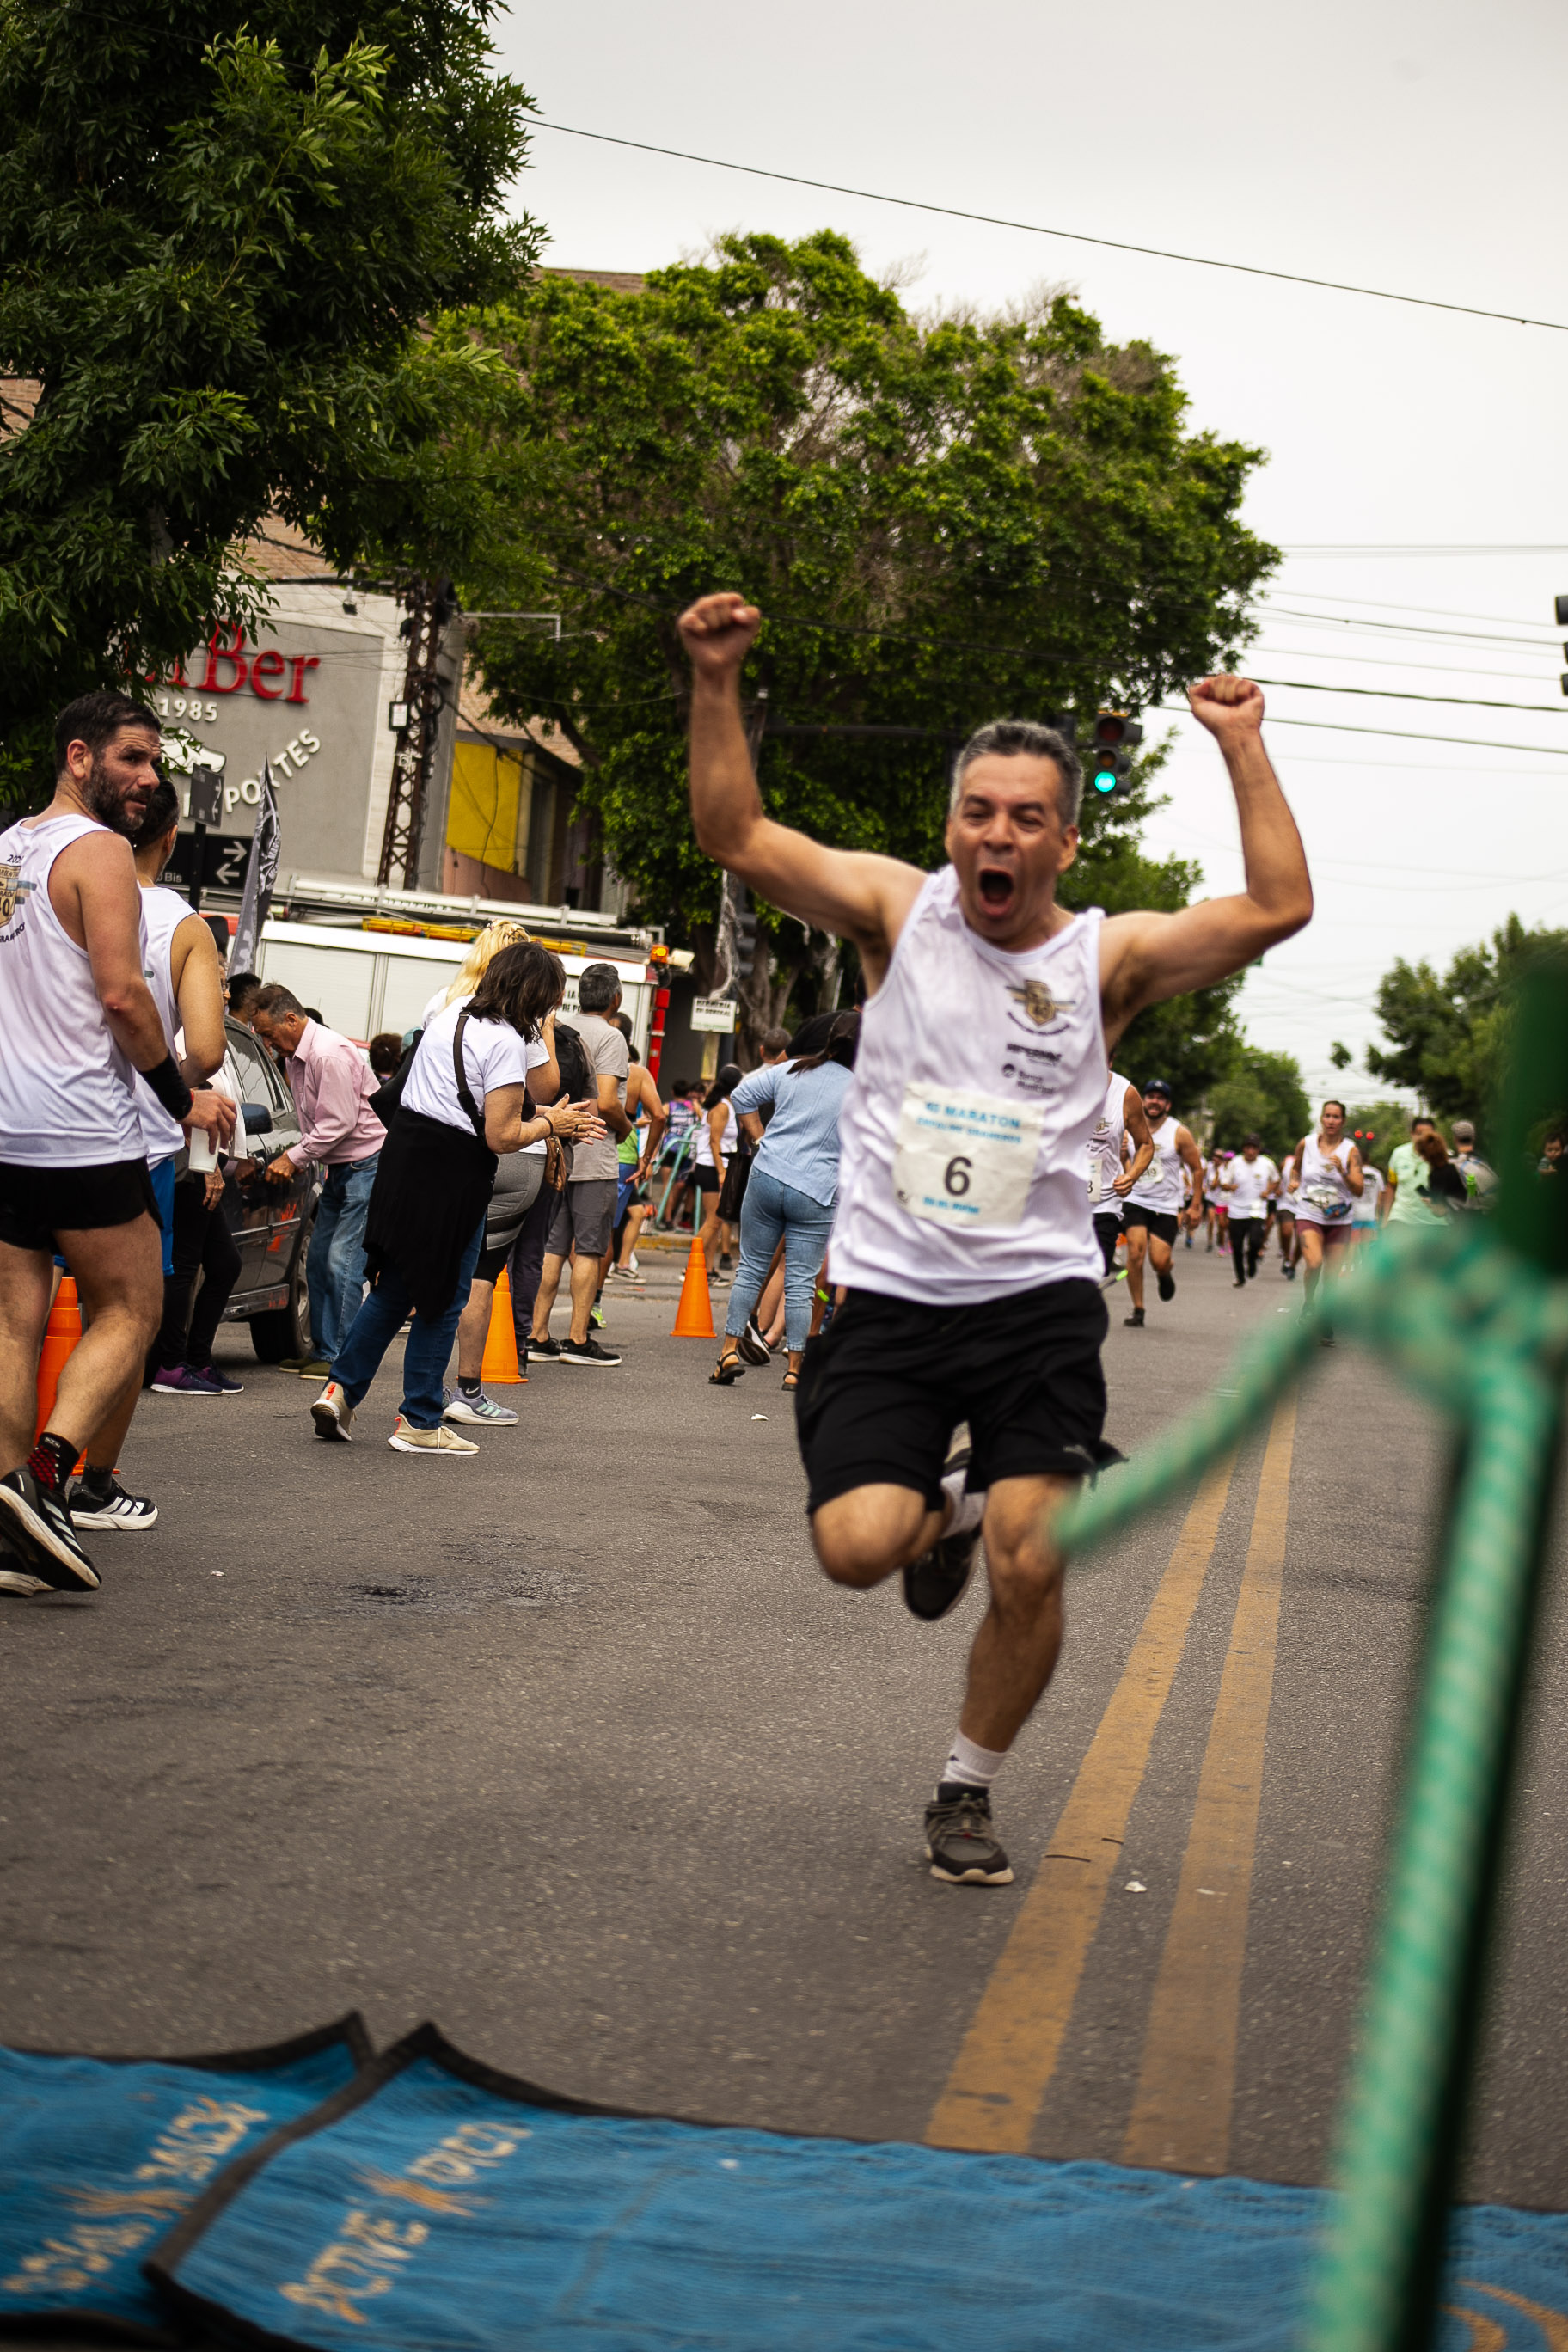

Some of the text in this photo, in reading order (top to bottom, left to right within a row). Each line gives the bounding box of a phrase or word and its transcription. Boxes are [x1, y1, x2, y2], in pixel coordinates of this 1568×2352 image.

[158, 697, 217, 722] 1985
[164, 872, 182, 883] Bis
[945, 1106, 1020, 1129] MARATON
[945, 1156, 973, 1197] 6
